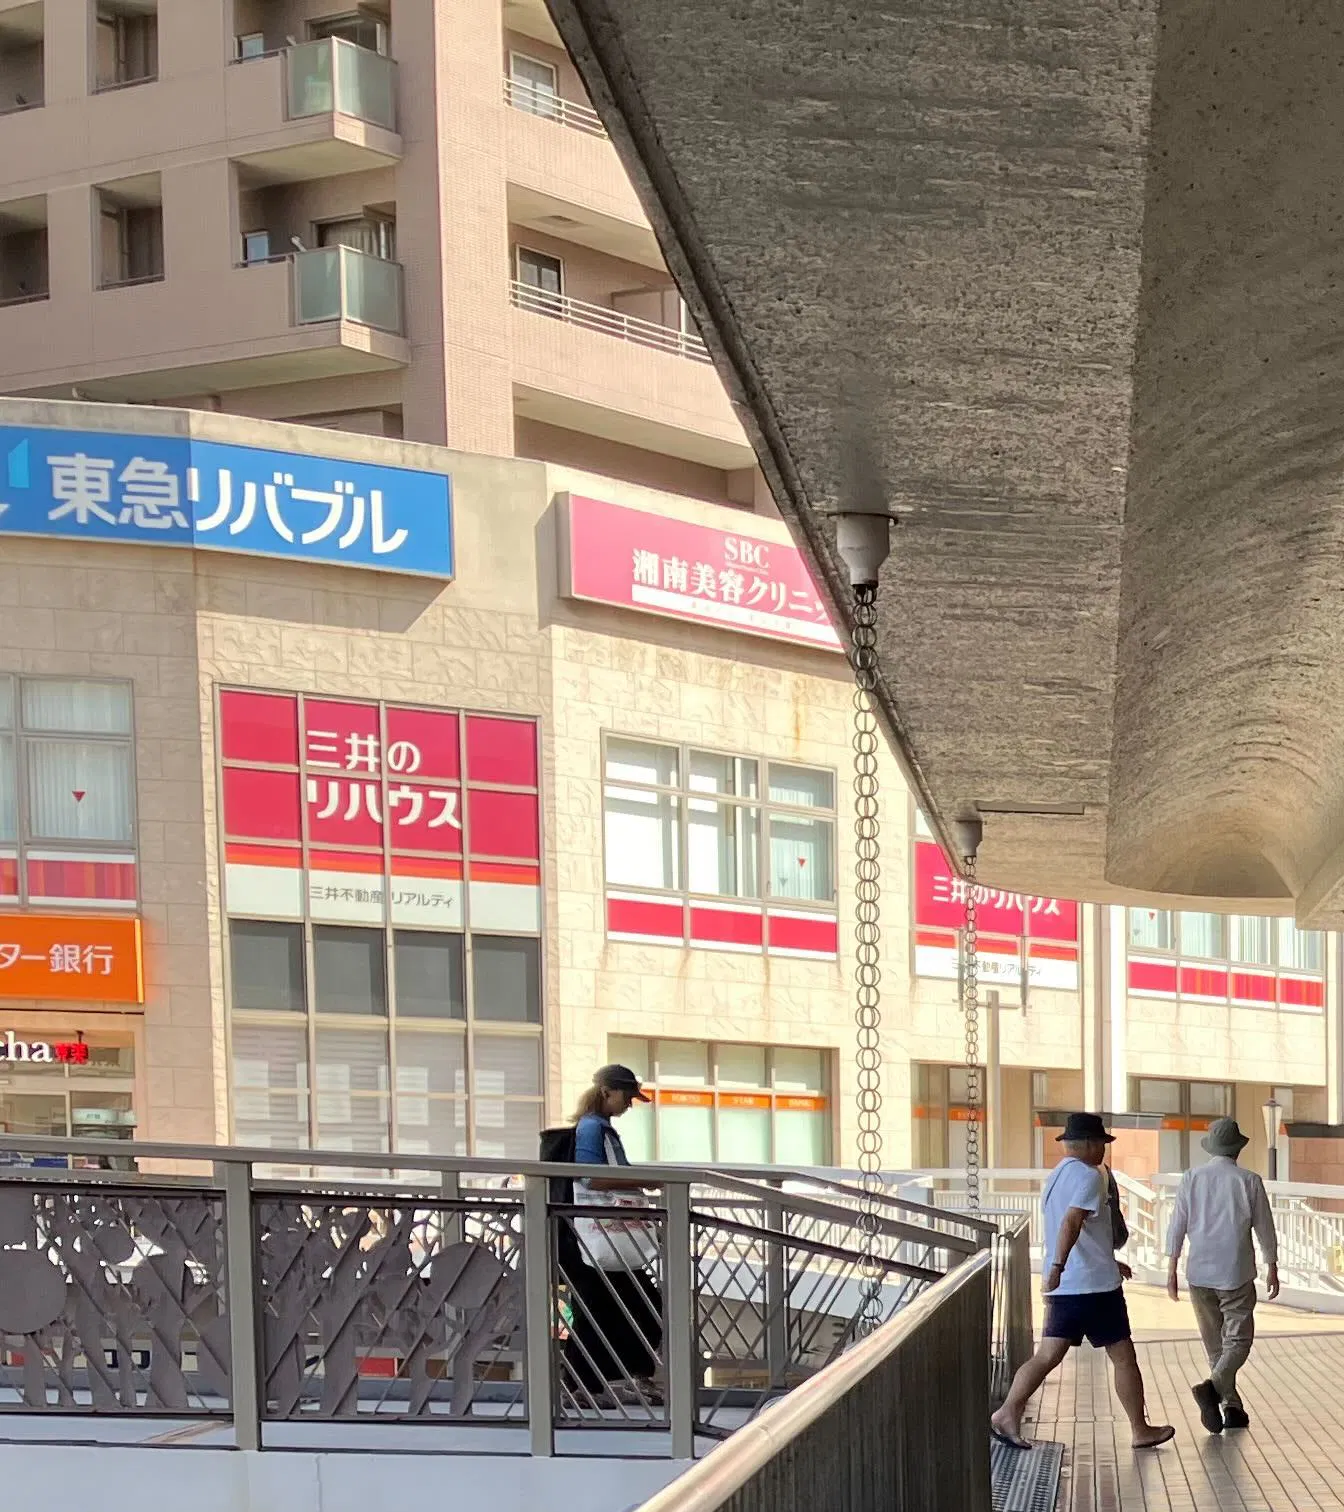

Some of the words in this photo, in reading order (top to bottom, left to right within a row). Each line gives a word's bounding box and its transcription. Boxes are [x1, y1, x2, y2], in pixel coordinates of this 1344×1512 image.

[47, 453, 408, 554] 東急リバブル
[724, 537, 769, 569] SBC
[306, 730, 421, 773] 三井の
[307, 780, 462, 829] リハウス
